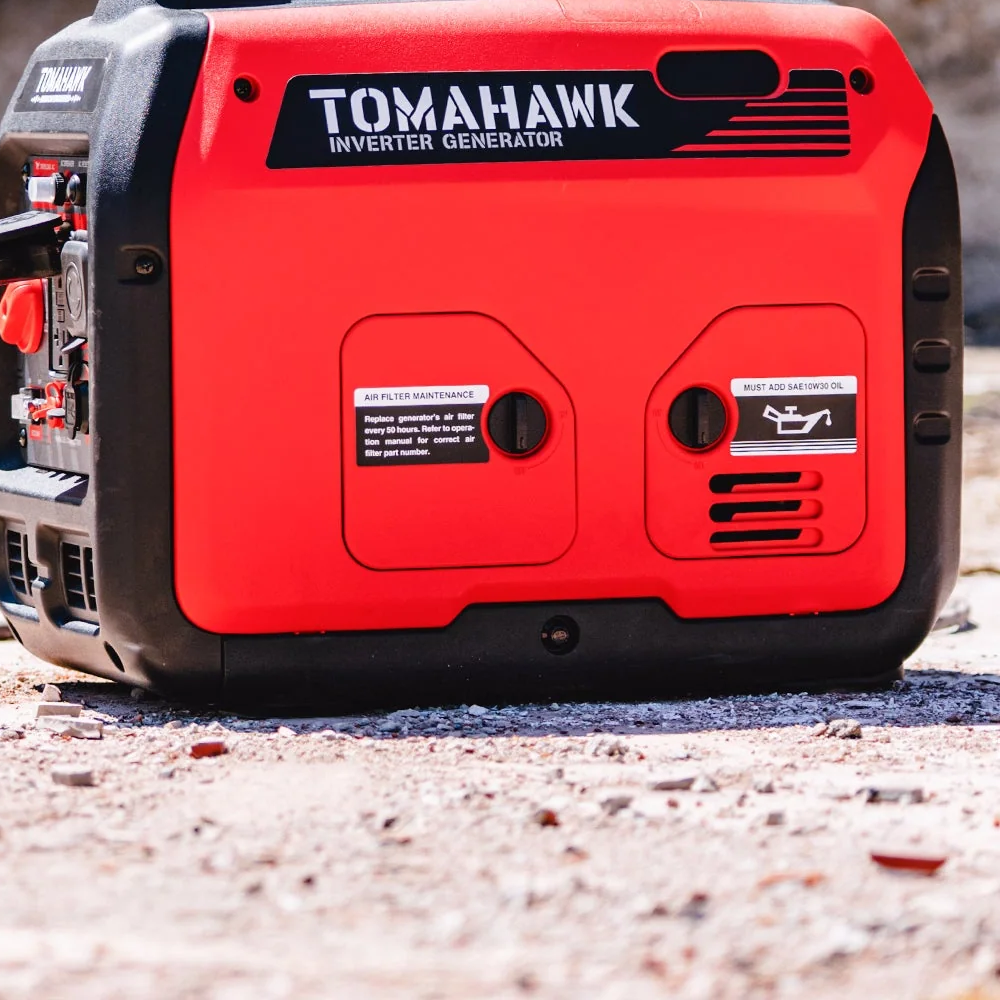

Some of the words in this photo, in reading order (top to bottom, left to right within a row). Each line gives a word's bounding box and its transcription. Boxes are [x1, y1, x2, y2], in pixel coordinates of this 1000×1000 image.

[309, 83, 640, 134] TOMAHAWK
[329, 134, 434, 153] INVERTER
[442, 131, 564, 149] GENERATOR
[743, 383, 766, 392] MUST
[768, 382, 786, 391] ADD
[787, 382, 829, 391] SAE10W30
[830, 381, 844, 390] OIL
[364, 393, 379, 401] AIR
[381, 392, 411, 401] FILTER
[413, 390, 474, 399] MAINTENANCE
[364, 415, 394, 424] Replace
[398, 413, 440, 423] generator's
[444, 413, 454, 421] air
[457, 412, 475, 420] filter
[386, 426, 396, 434] 50
[421, 425, 441, 433] Refer
[451, 425, 475, 433] opera-
[364, 438, 380, 446] tion
[384, 437, 412, 445] manual
[417, 436, 428, 444] for
[433, 435, 460, 444] correct
[464, 435, 475, 443] air
[364, 449, 383, 457] filter
[383, 449, 400, 458] part
[399, 448, 431, 456] number.
